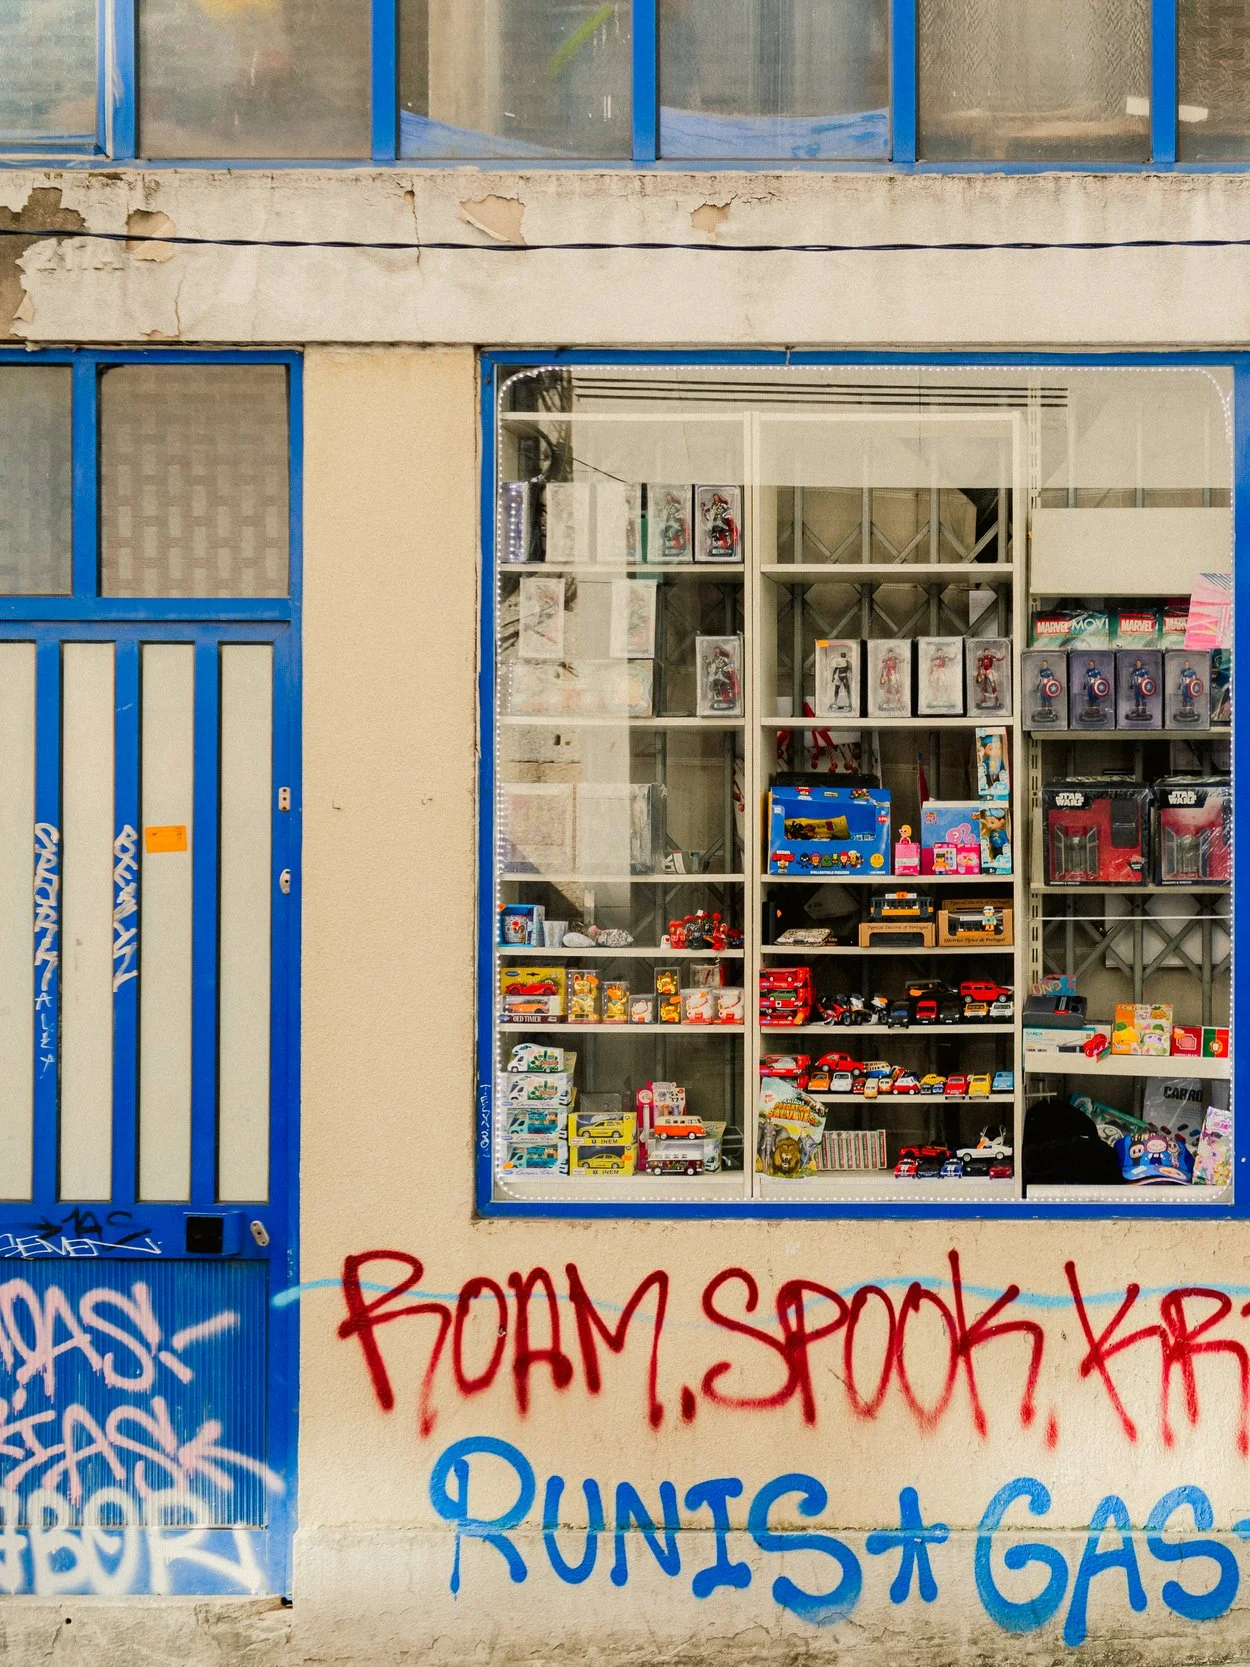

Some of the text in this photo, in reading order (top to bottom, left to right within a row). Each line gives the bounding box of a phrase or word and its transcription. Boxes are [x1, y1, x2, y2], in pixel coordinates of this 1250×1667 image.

[1037, 620, 1070, 634] MARVEL
[1120, 618, 1154, 632] MARVEL
[1032, 980, 1062, 995] UNO
